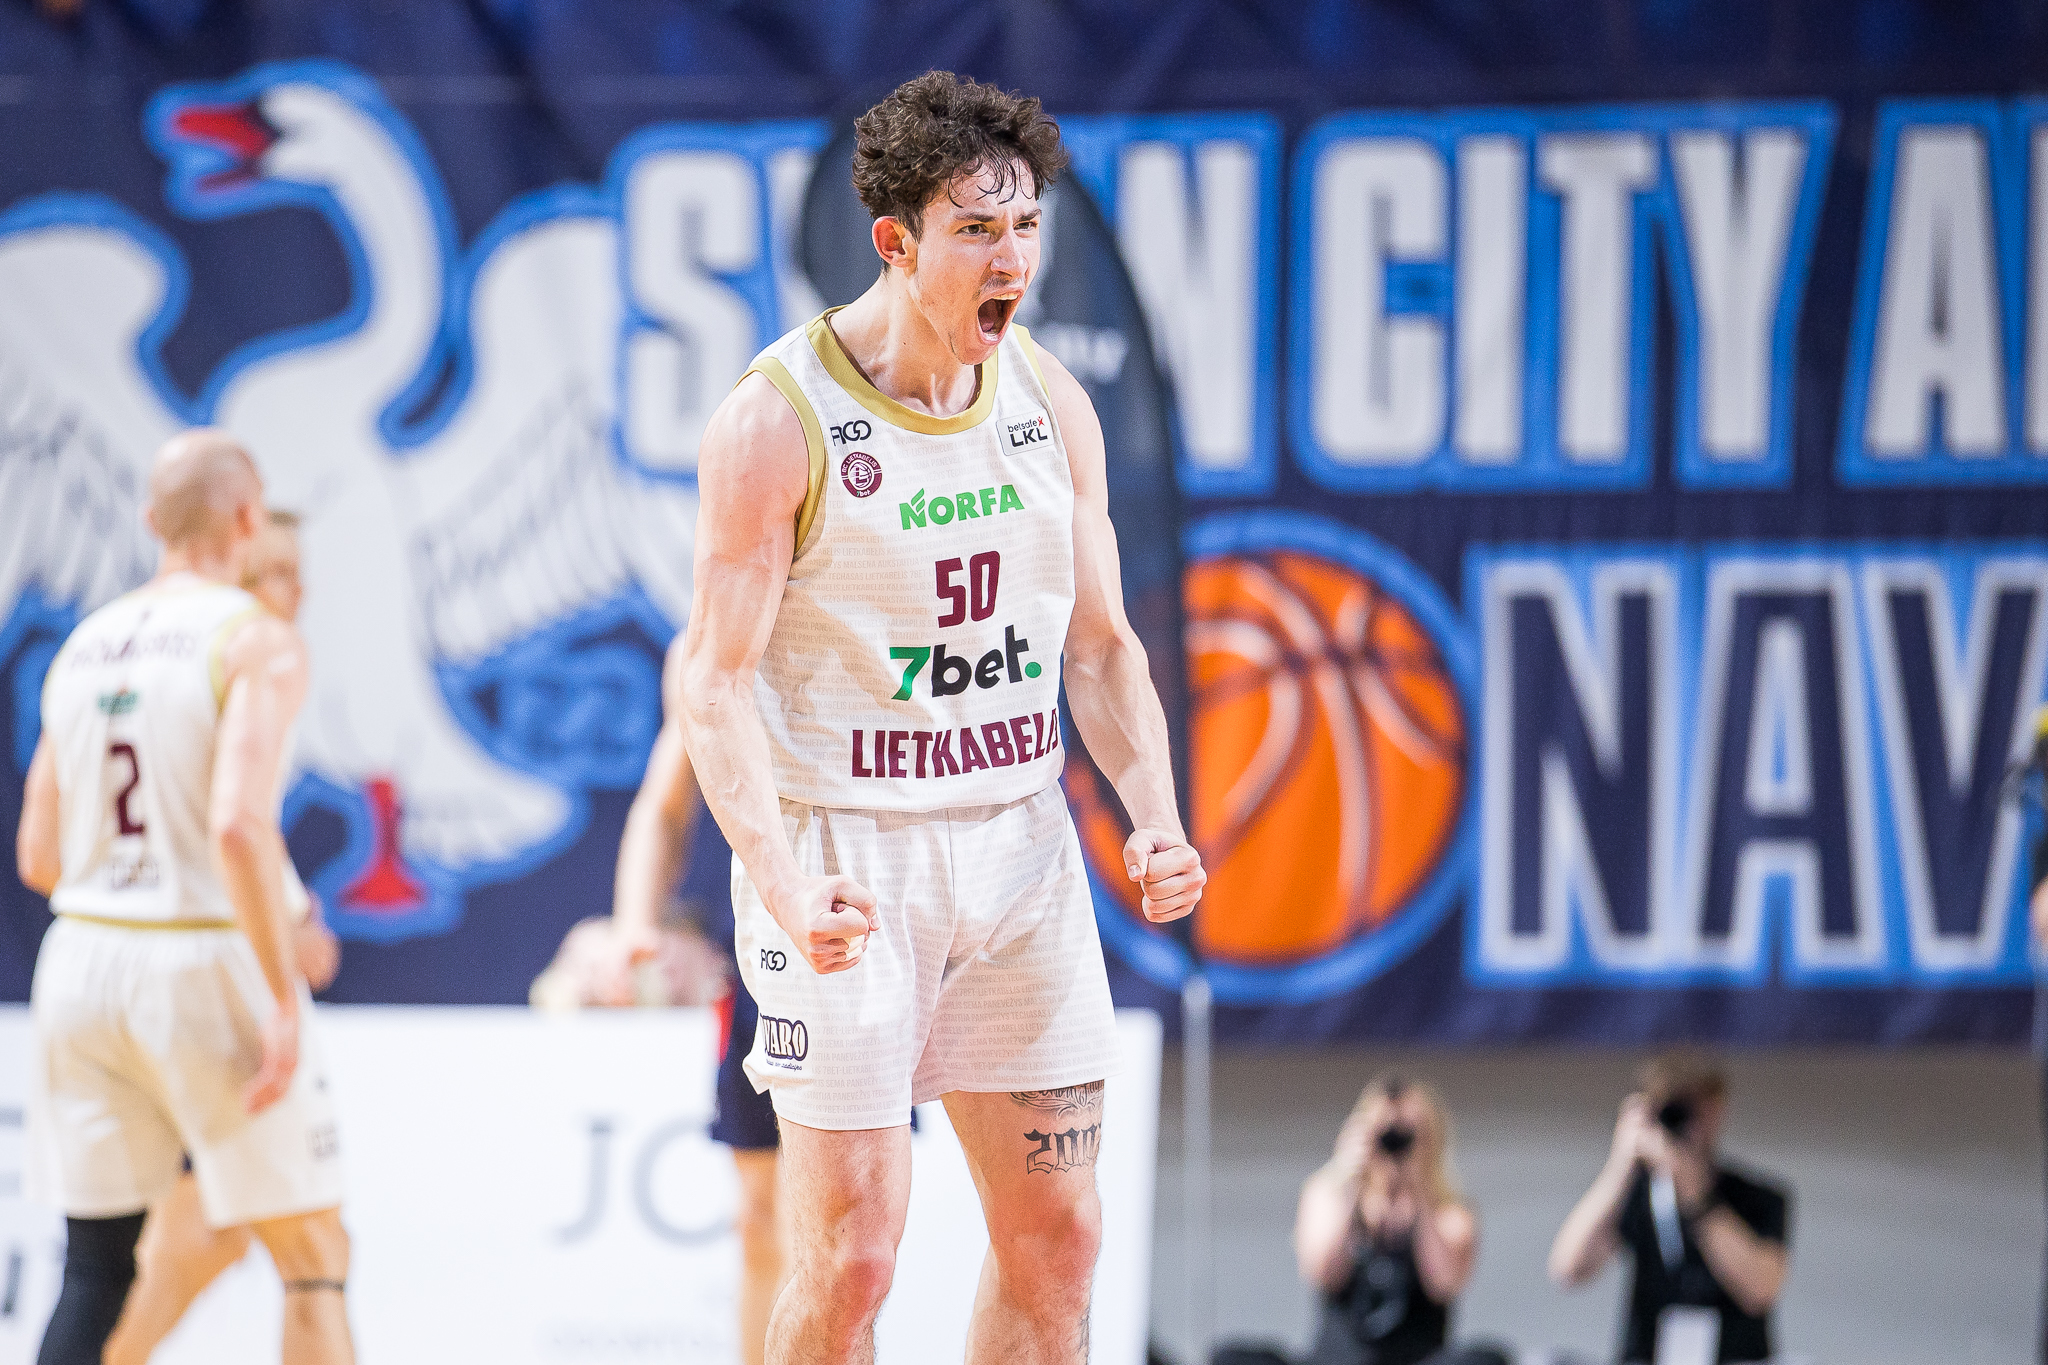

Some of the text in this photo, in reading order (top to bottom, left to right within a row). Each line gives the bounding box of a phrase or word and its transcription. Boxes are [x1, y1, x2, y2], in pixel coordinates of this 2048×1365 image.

[1311, 129, 1804, 465] CITY
[1864, 123, 2048, 461] A
[1007, 419, 1038, 433] betsafe
[1010, 428, 1048, 447] LKL
[899, 484, 1025, 530] NORFA
[935, 551, 1001, 628] 50
[108, 743, 146, 836] 2
[760, 1013, 808, 1061] VARO
